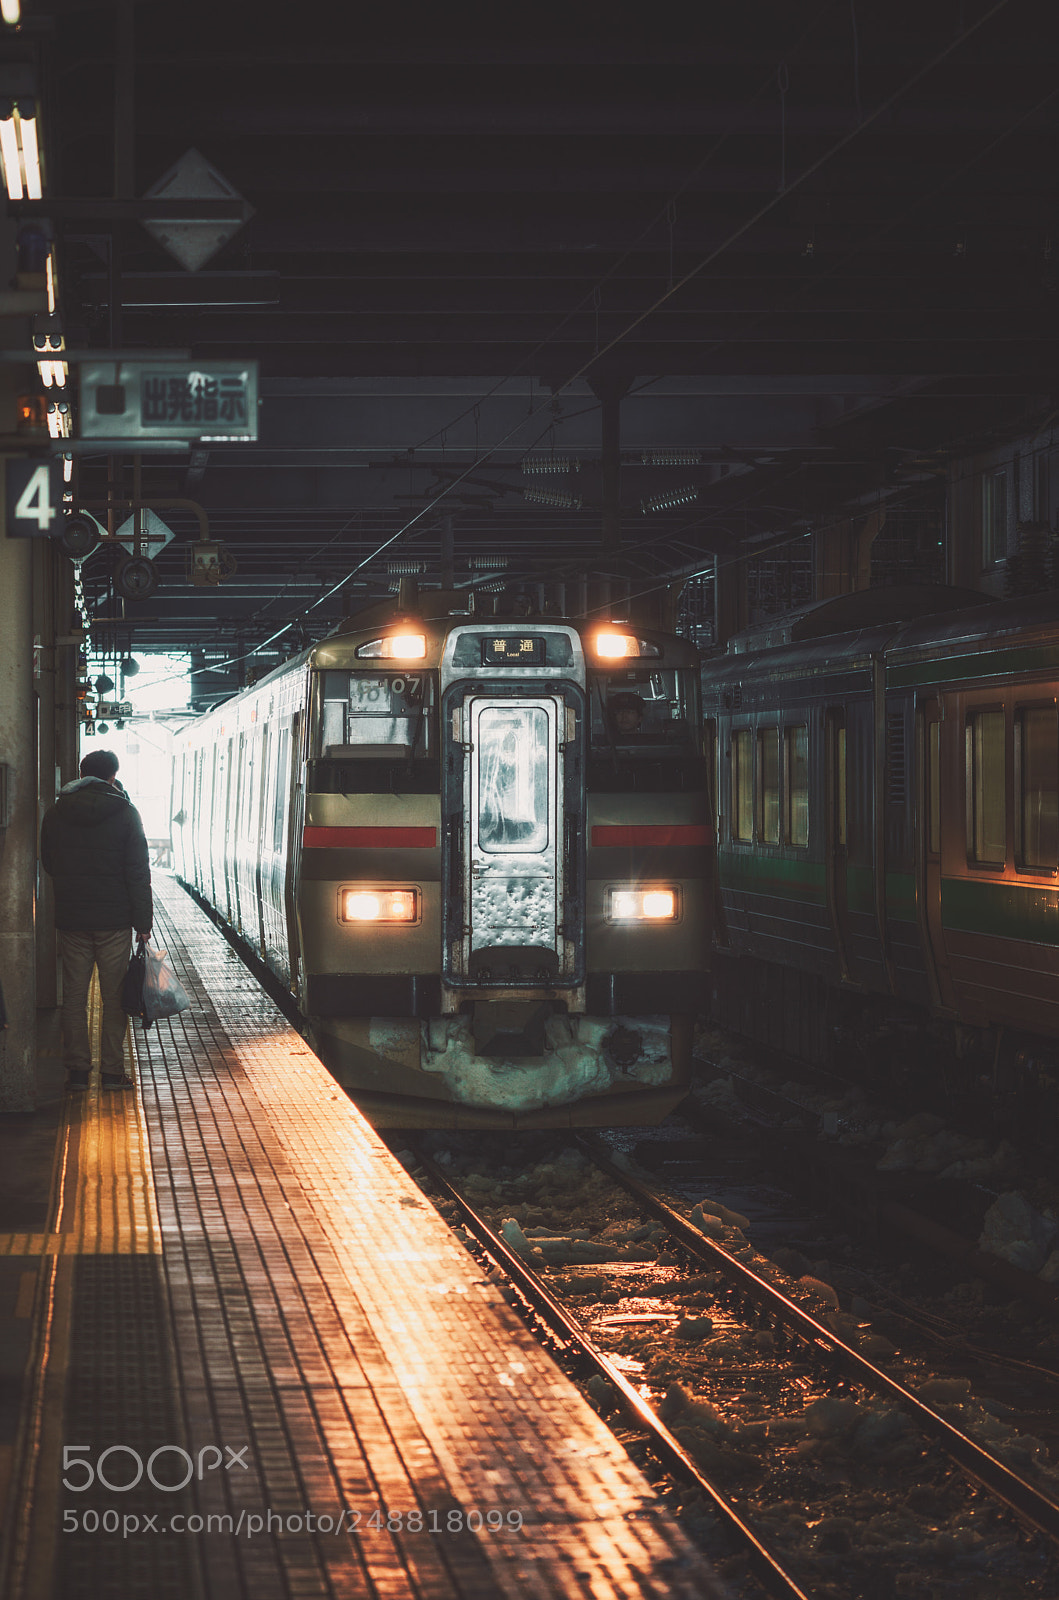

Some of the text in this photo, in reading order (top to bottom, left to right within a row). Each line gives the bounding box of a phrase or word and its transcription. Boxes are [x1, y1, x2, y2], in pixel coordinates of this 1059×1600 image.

[144, 377, 246, 422] 出発指示
[15, 466, 56, 530] 4
[493, 639, 534, 652] 普通
[86, 723, 95, 735] 4
